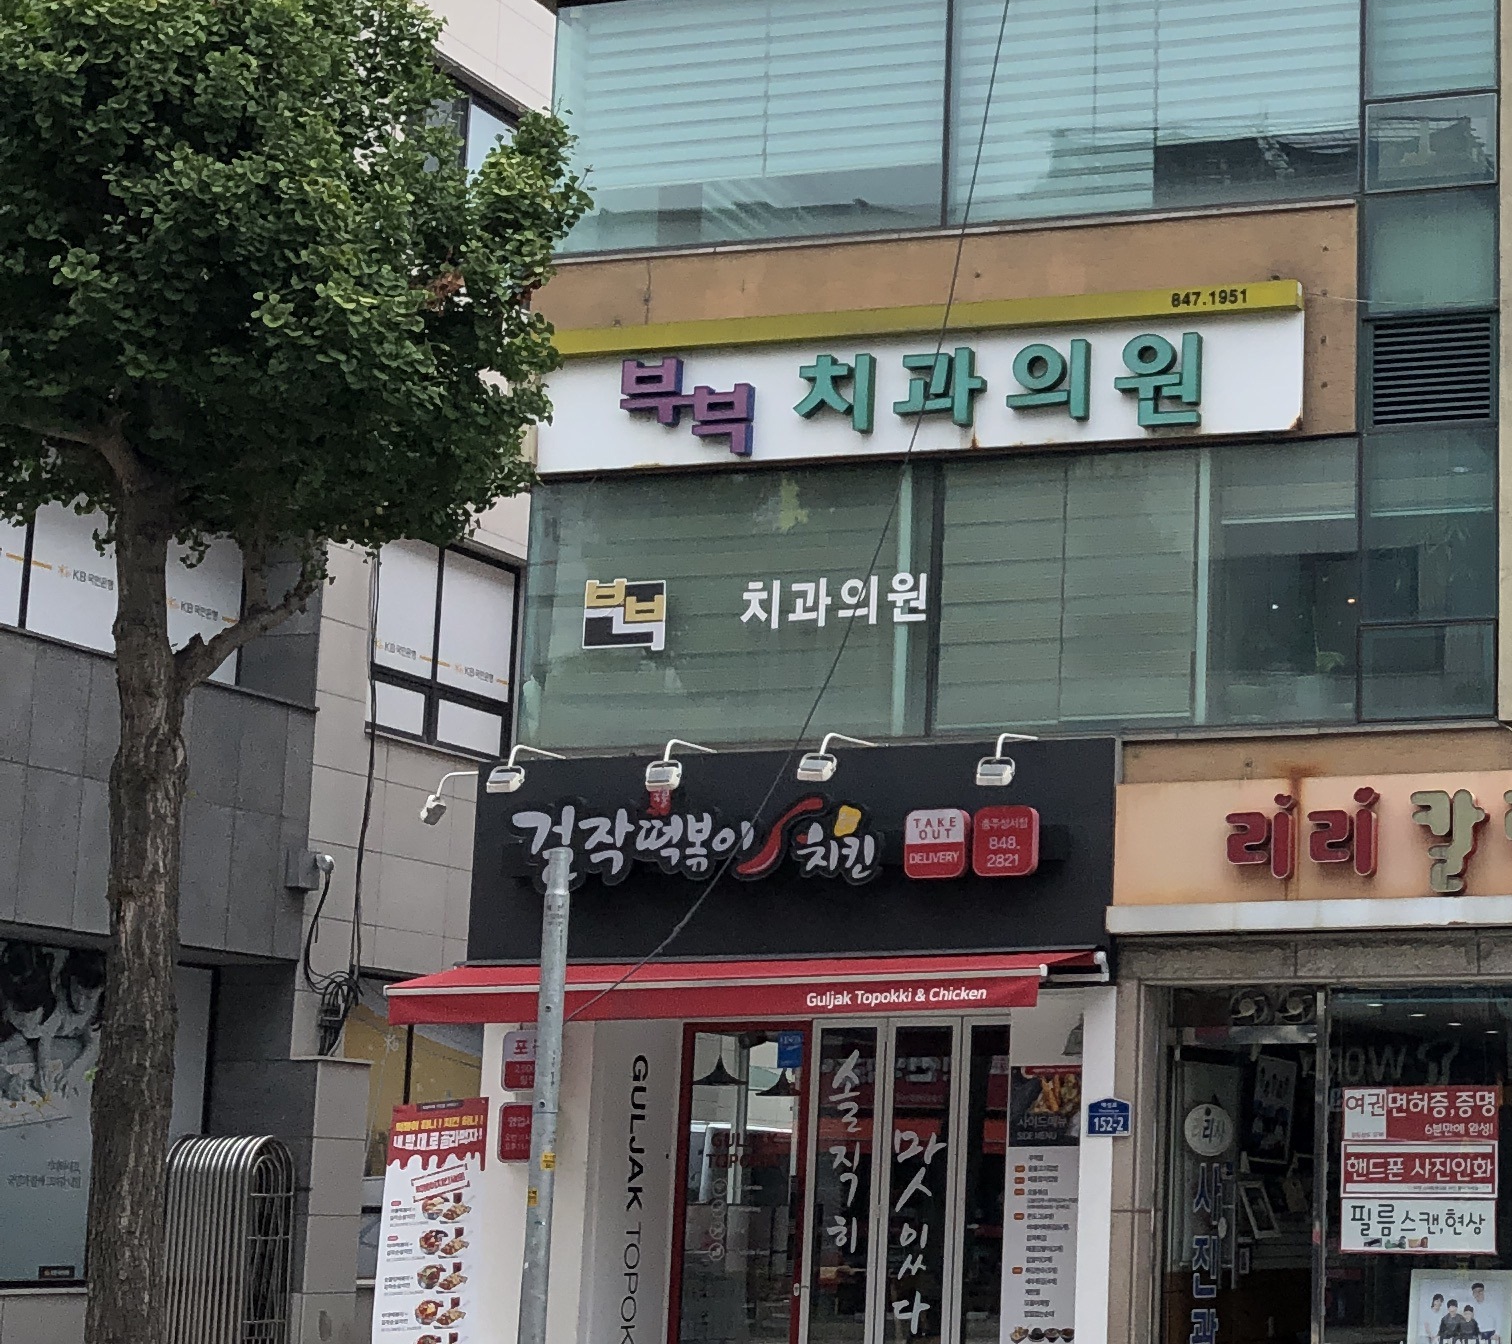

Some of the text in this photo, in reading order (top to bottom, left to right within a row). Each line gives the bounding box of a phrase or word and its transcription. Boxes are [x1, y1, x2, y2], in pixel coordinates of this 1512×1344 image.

[1169, 288, 1250, 309] 847.1951
[792, 331, 1203, 435] 치과의원
[739, 571, 928, 630] 치과의원
[913, 817, 957, 829] TAKE
[918, 829, 952, 840] OUT
[797, 823, 875, 879] 치킨
[909, 851, 960, 864] DELIVERY
[987, 854, 1019, 867] 2821
[806, 987, 987, 1008] Guljak Topokki & Chicken
[1345, 1090, 1496, 1118] 여권 면허증,증명
[626, 1054, 649, 1212] GULJAK
[1093, 1116, 1124, 1132] 152-2
[827, 1049, 862, 1254] 솔직히
[1347, 1156, 1494, 1181] 핸드폰 사진인화
